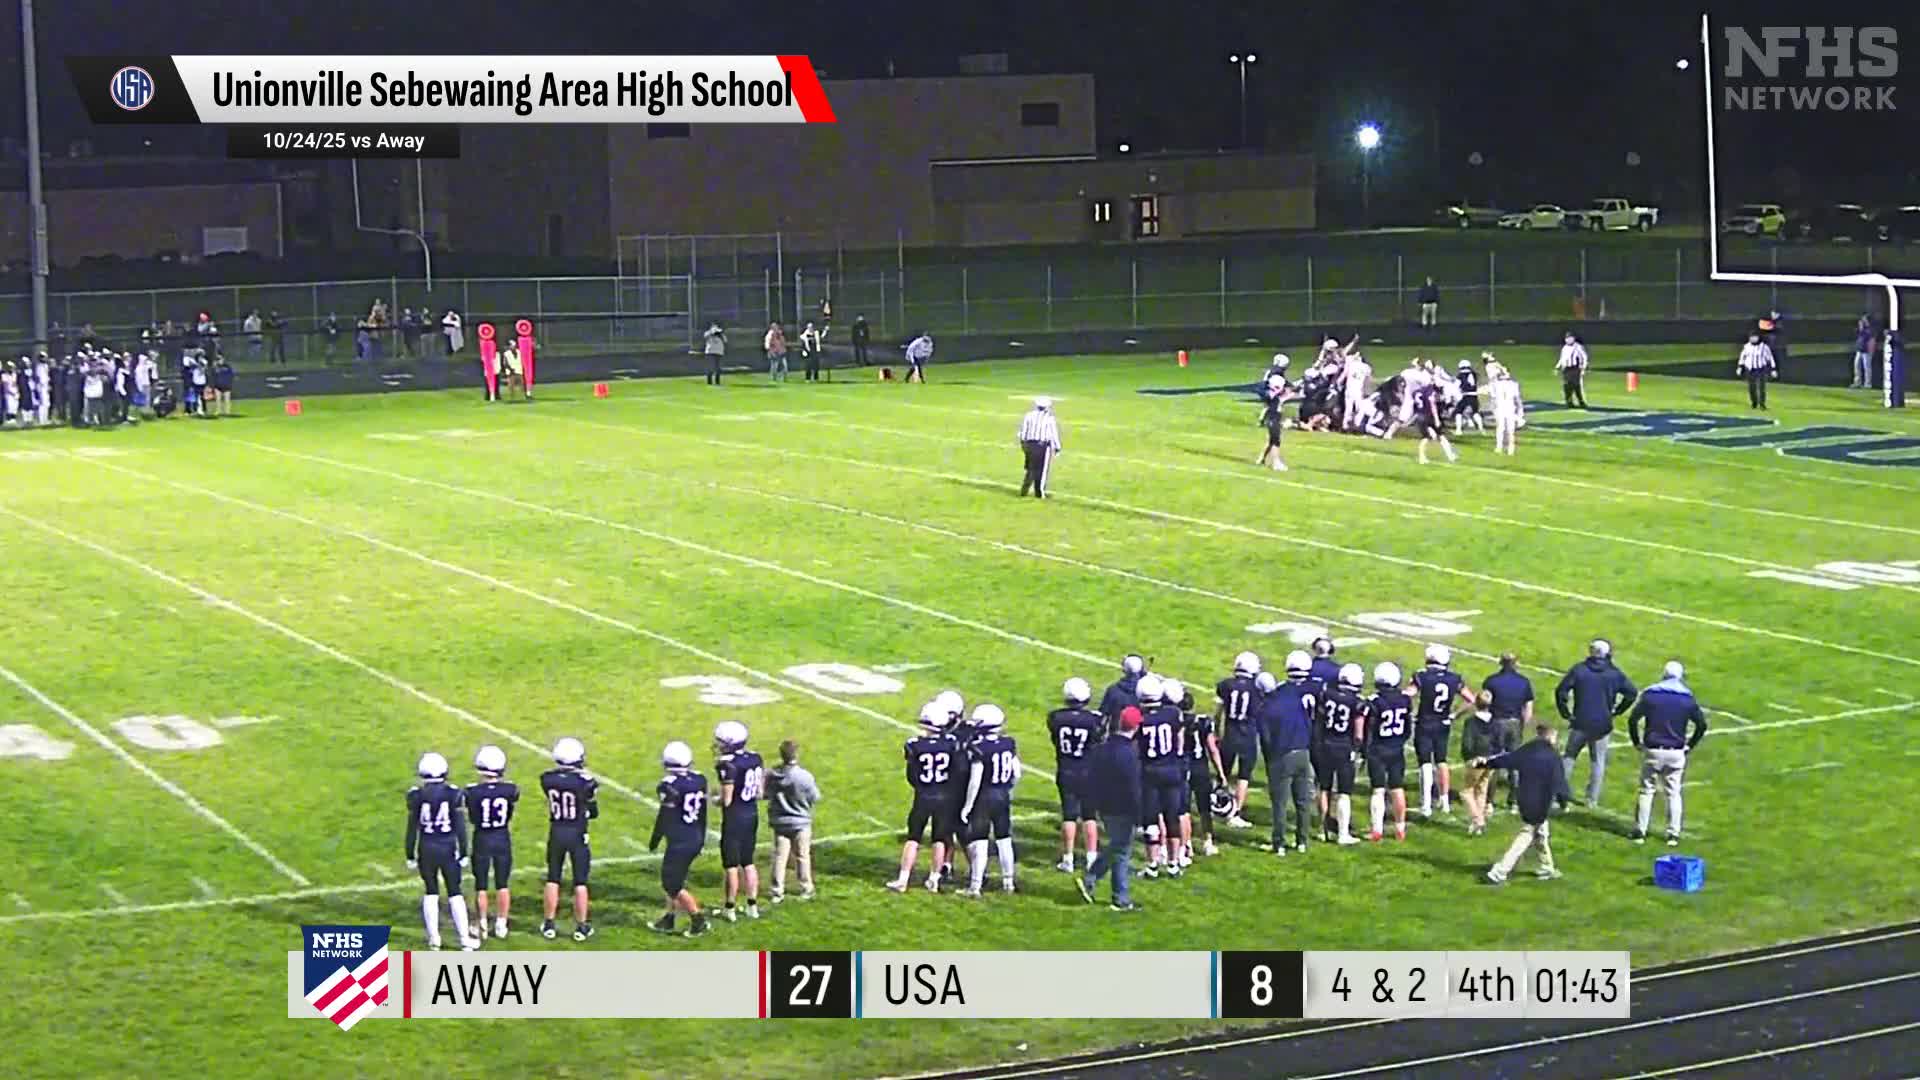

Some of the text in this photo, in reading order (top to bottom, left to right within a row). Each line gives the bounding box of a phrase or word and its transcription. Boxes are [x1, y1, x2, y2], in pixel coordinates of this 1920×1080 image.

[1229, 688, 1250, 721] 11
[1433, 682, 1449, 713] 2
[1324, 699, 1351, 733] 33
[1379, 707, 1407, 737] 25
[1058, 725, 1088, 757] 67
[1142, 723, 1173, 758] 70
[918, 752, 950, 784] 32
[419, 800, 452, 834] 44
[480, 797, 509, 829] 13
[549, 789, 577, 821] 60
